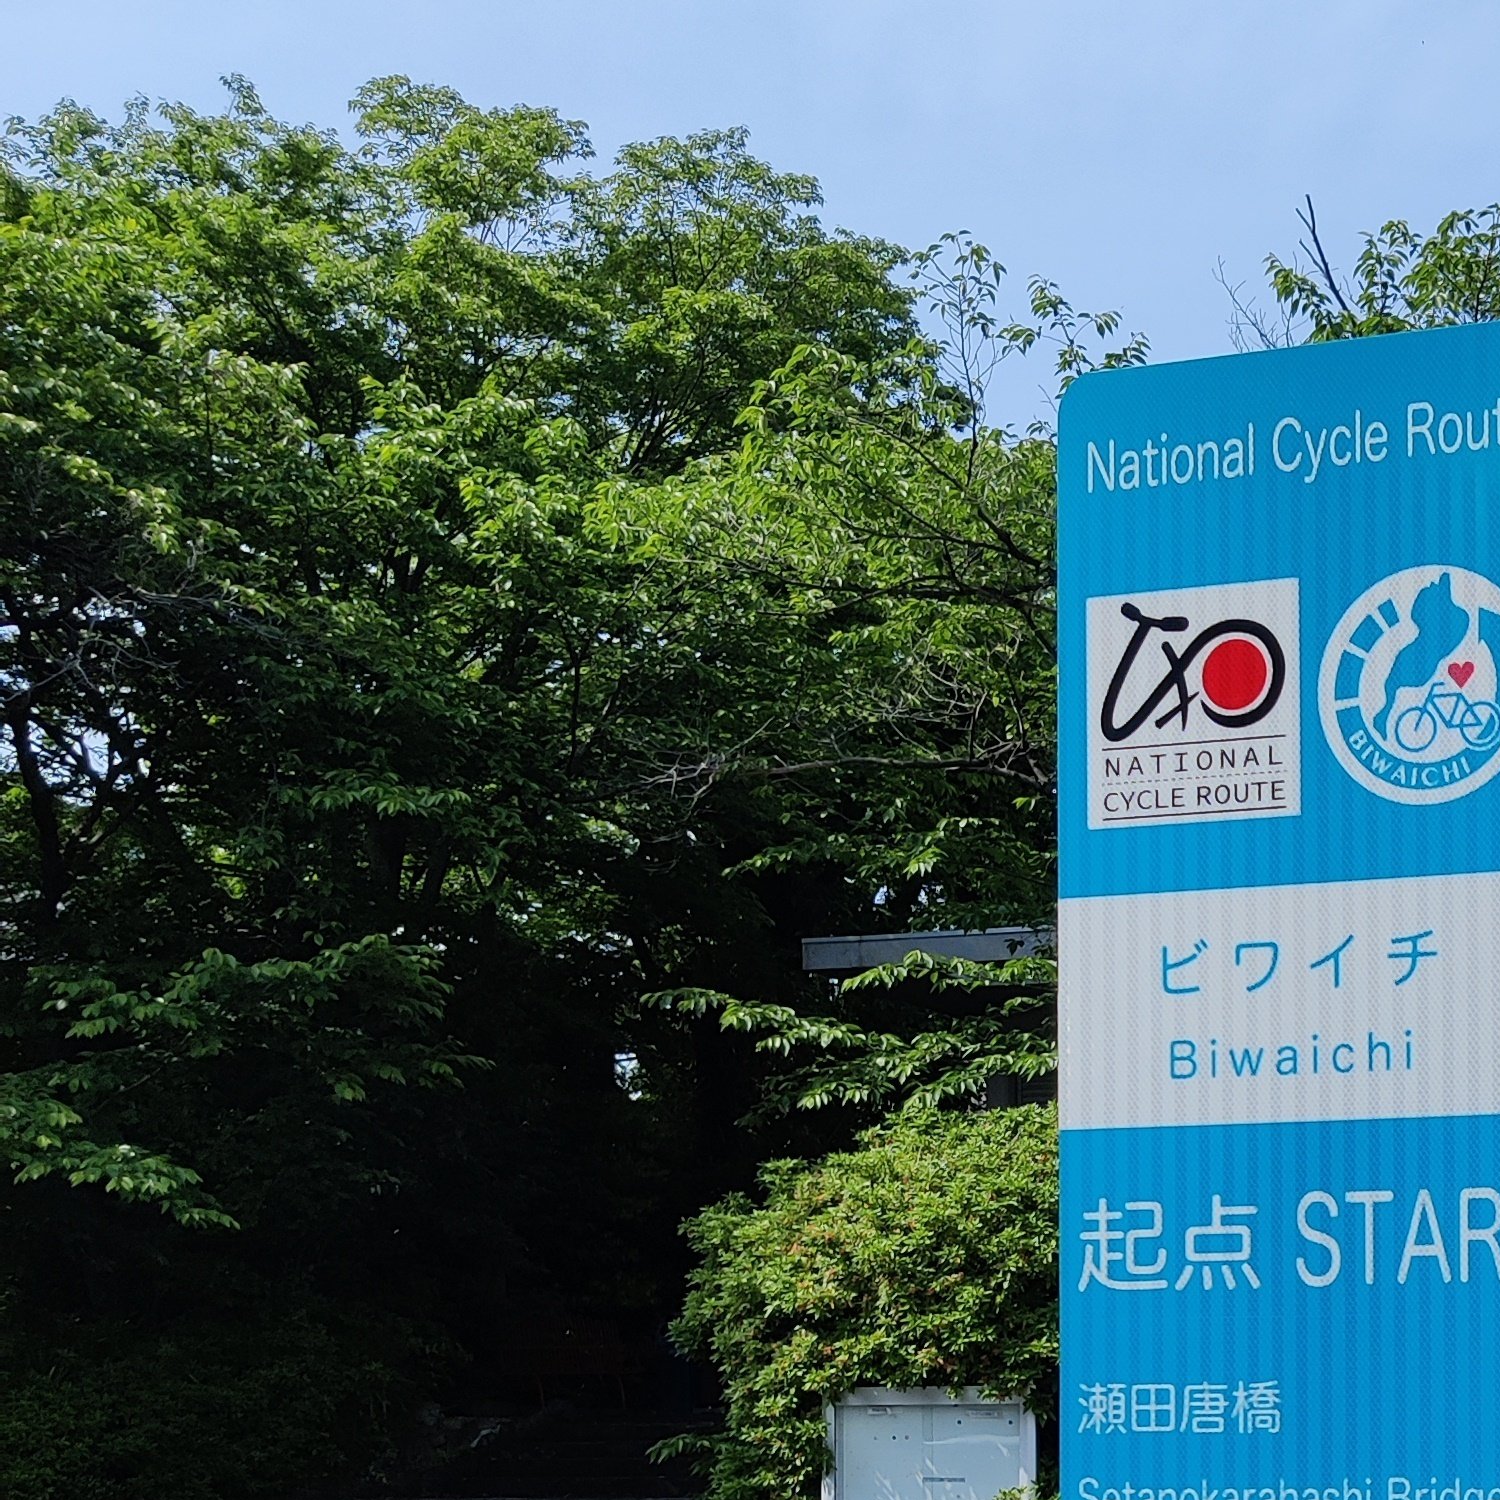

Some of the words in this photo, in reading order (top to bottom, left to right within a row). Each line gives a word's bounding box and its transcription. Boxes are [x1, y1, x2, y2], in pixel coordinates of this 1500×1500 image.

[1087, 423, 1254, 493] National
[1272, 410, 1388, 483] Cycle
[1105, 746, 1283, 777] NATIONAL
[1349, 731, 1471, 788] BIWAICHI
[1103, 785, 1185, 813] CYCLE
[1197, 780, 1285, 807] ROUTE
[1161, 929, 1438, 994] ビワイチ
[1170, 1030, 1414, 1080] Biwaichi
[1078, 1195, 1261, 1292] 起点
[1077, 1380, 1281, 1434] 瀬田唐橋
